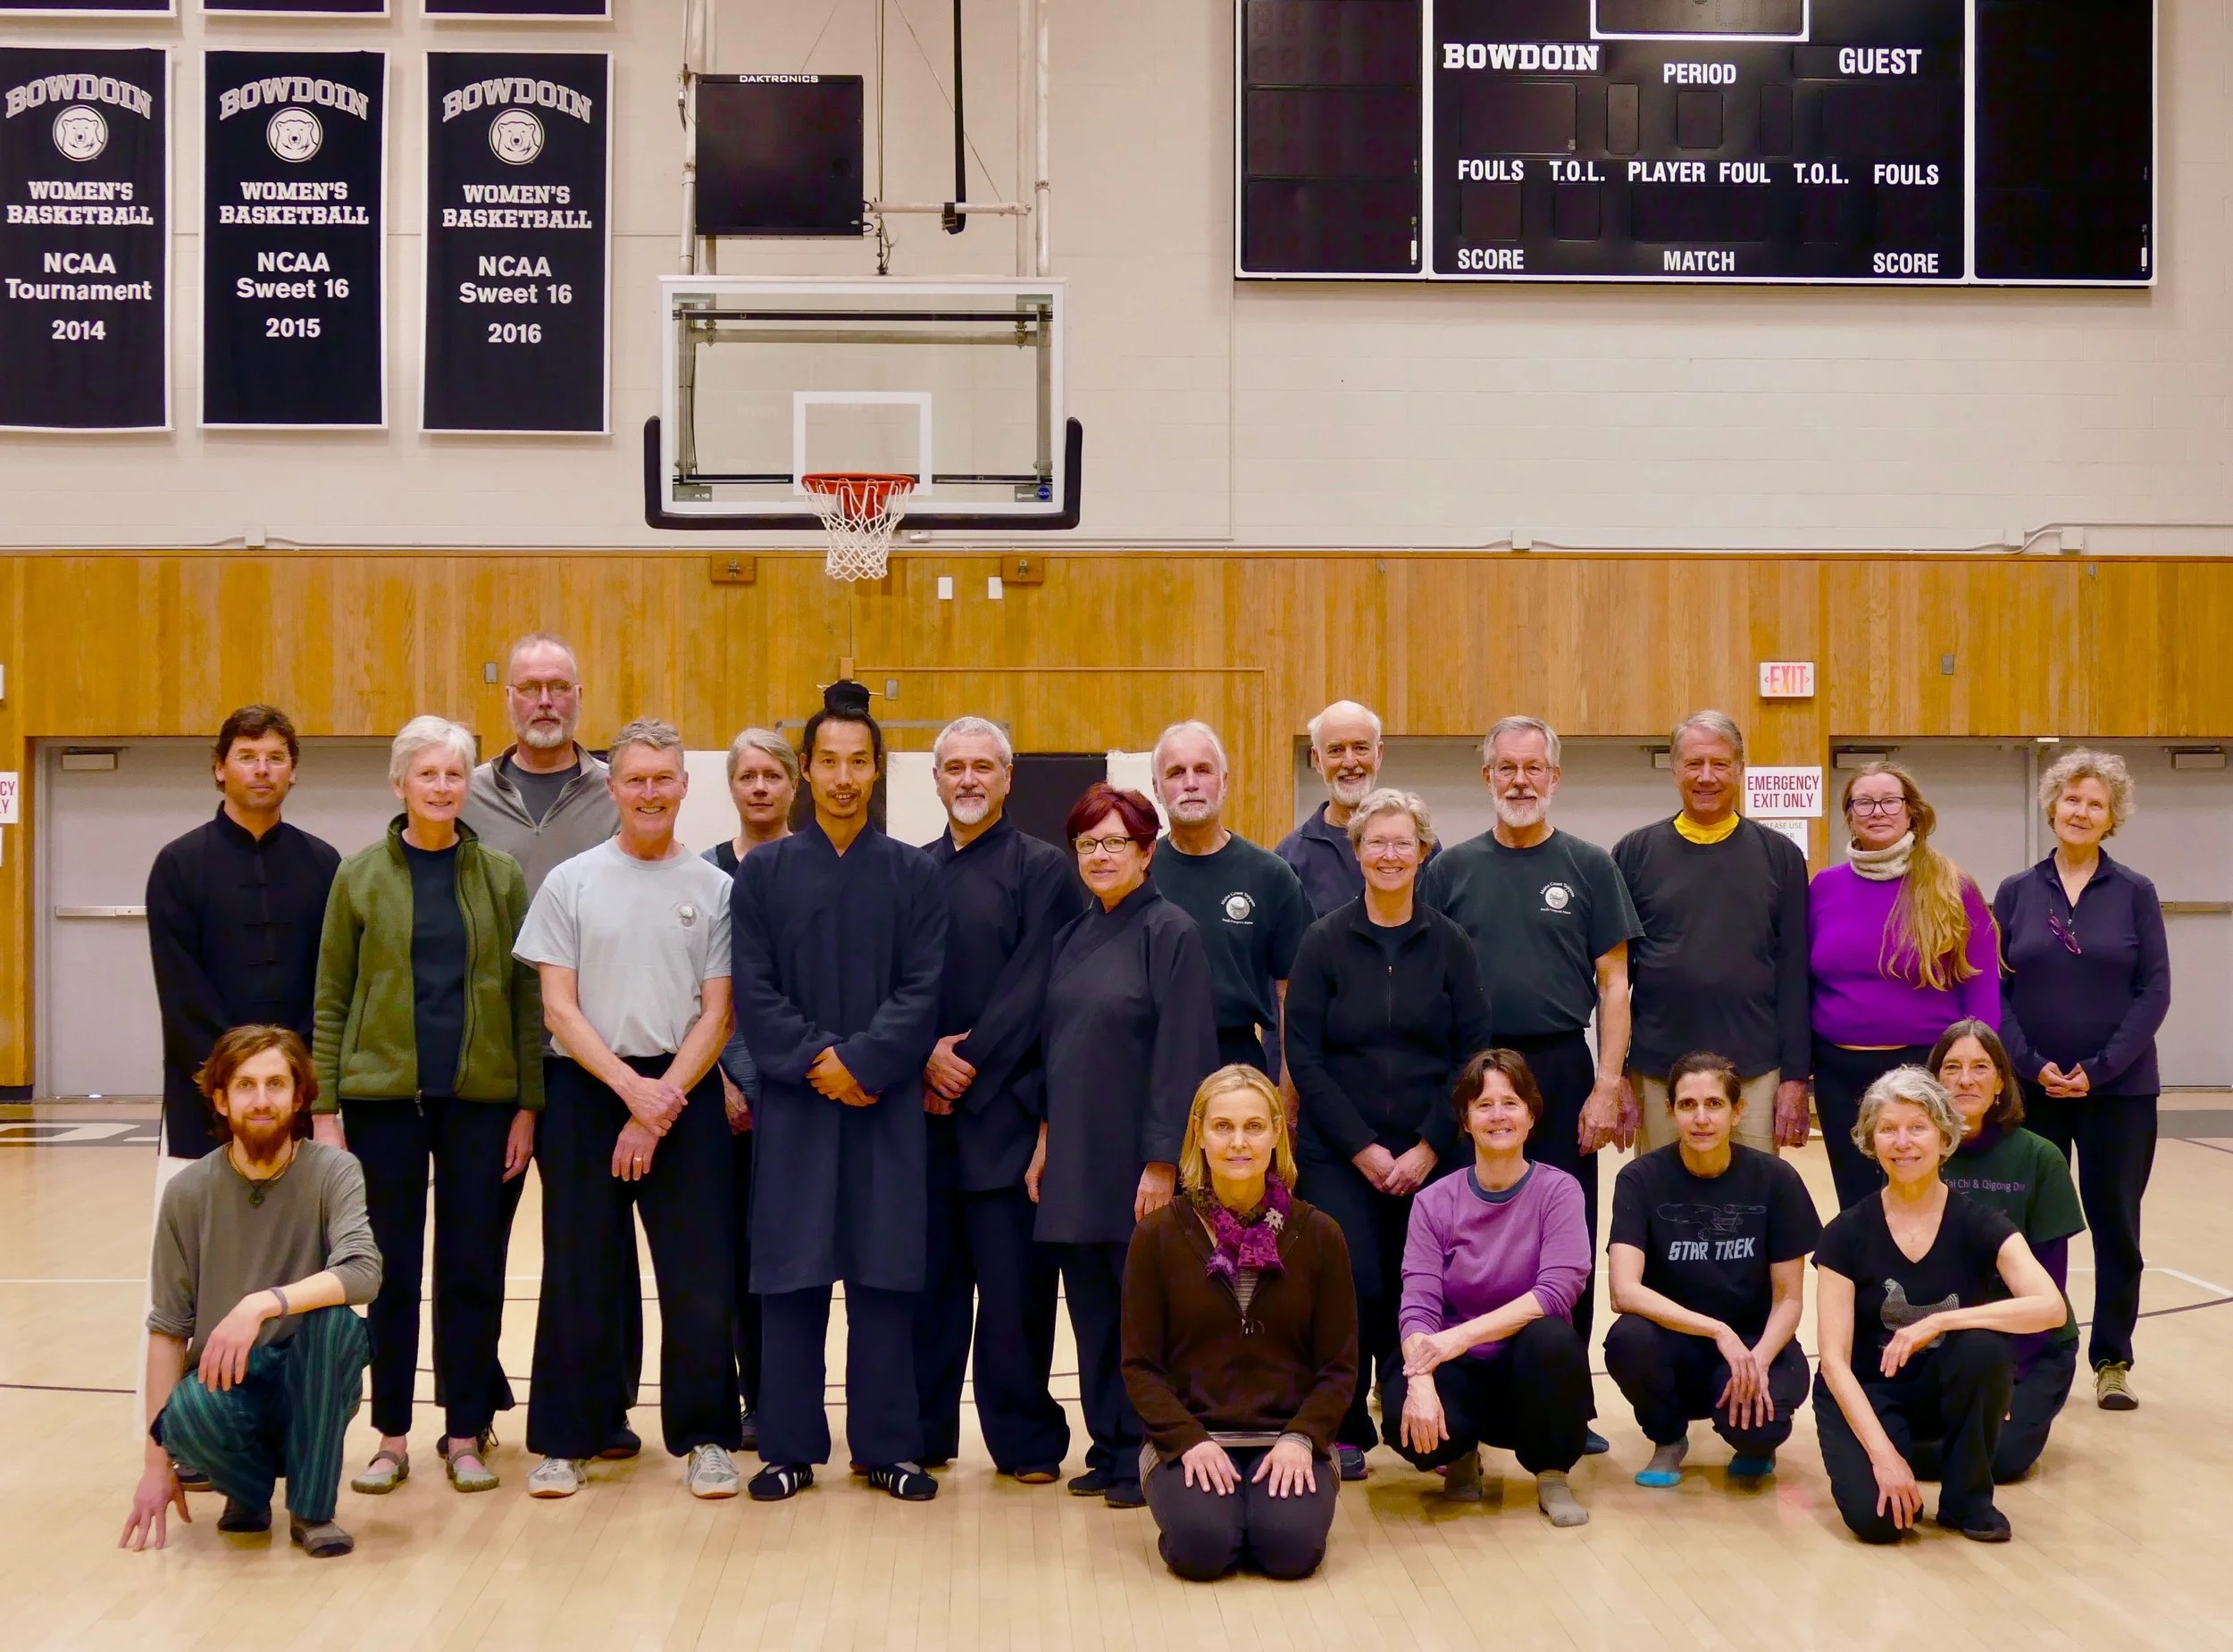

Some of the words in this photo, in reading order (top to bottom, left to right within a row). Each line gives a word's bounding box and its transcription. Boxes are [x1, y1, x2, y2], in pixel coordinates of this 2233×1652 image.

[1443, 43, 1600, 71] BOWDOIN
[1838, 48, 1922, 75] GUEST
[739, 75, 819, 83] DAKTRONICS
[1663, 63, 1737, 85] PERIOD
[5, 74, 153, 120] BOWDOIN
[219, 77, 369, 121] BOWDOIN
[442, 78, 592, 123] BOWDOIN
[1458, 160, 1525, 181] FOULS
[1549, 161, 1605, 182] T.O.L.
[1627, 162, 1706, 183] PLAYER
[1719, 163, 1771, 184] FOUL
[1793, 163, 1849, 185] T.O.L.
[1874, 164, 1939, 186] FOULS
[28, 181, 134, 201] WOMEN'S
[240, 182, 348, 201] WOMEN'S
[463, 185, 571, 204] WOMEN'S
[6, 205, 154, 226] BASKETBALL
[219, 205, 370, 225] BASKETBALL
[442, 209, 592, 229] BASKETBALL
[44, 253, 117, 274] NCAA
[257, 252, 330, 272] NCAA
[478, 256, 552, 277] NCAA
[1458, 249, 1525, 270] SCORE
[1663, 251, 1735, 271] MATCH
[1873, 253, 1939, 274] SCORE
[5, 279, 153, 301] Tournament
[236, 278, 316, 299] Sweet
[323, 280, 349, 298] 16
[458, 282, 539, 305] Sweet
[547, 285, 573, 305] 16
[52, 320, 106, 341] 2014
[265, 318, 321, 338] 2015
[488, 323, 542, 344] 2016
[1769, 665, 1807, 694] EXIT
[1747, 775, 1819, 790] EMERGENCY
[1753, 793, 1780, 808] EXIT
[1783, 793, 1814, 808] ONLY
[1958, 1179, 1970, 1189] Chi
[1972, 1179, 1980, 1189] &
[1982, 1180, 2011, 1193] Qigong
[1668, 1240, 1709, 1261] STAR
[1715, 1237, 1755, 1261] TREK
